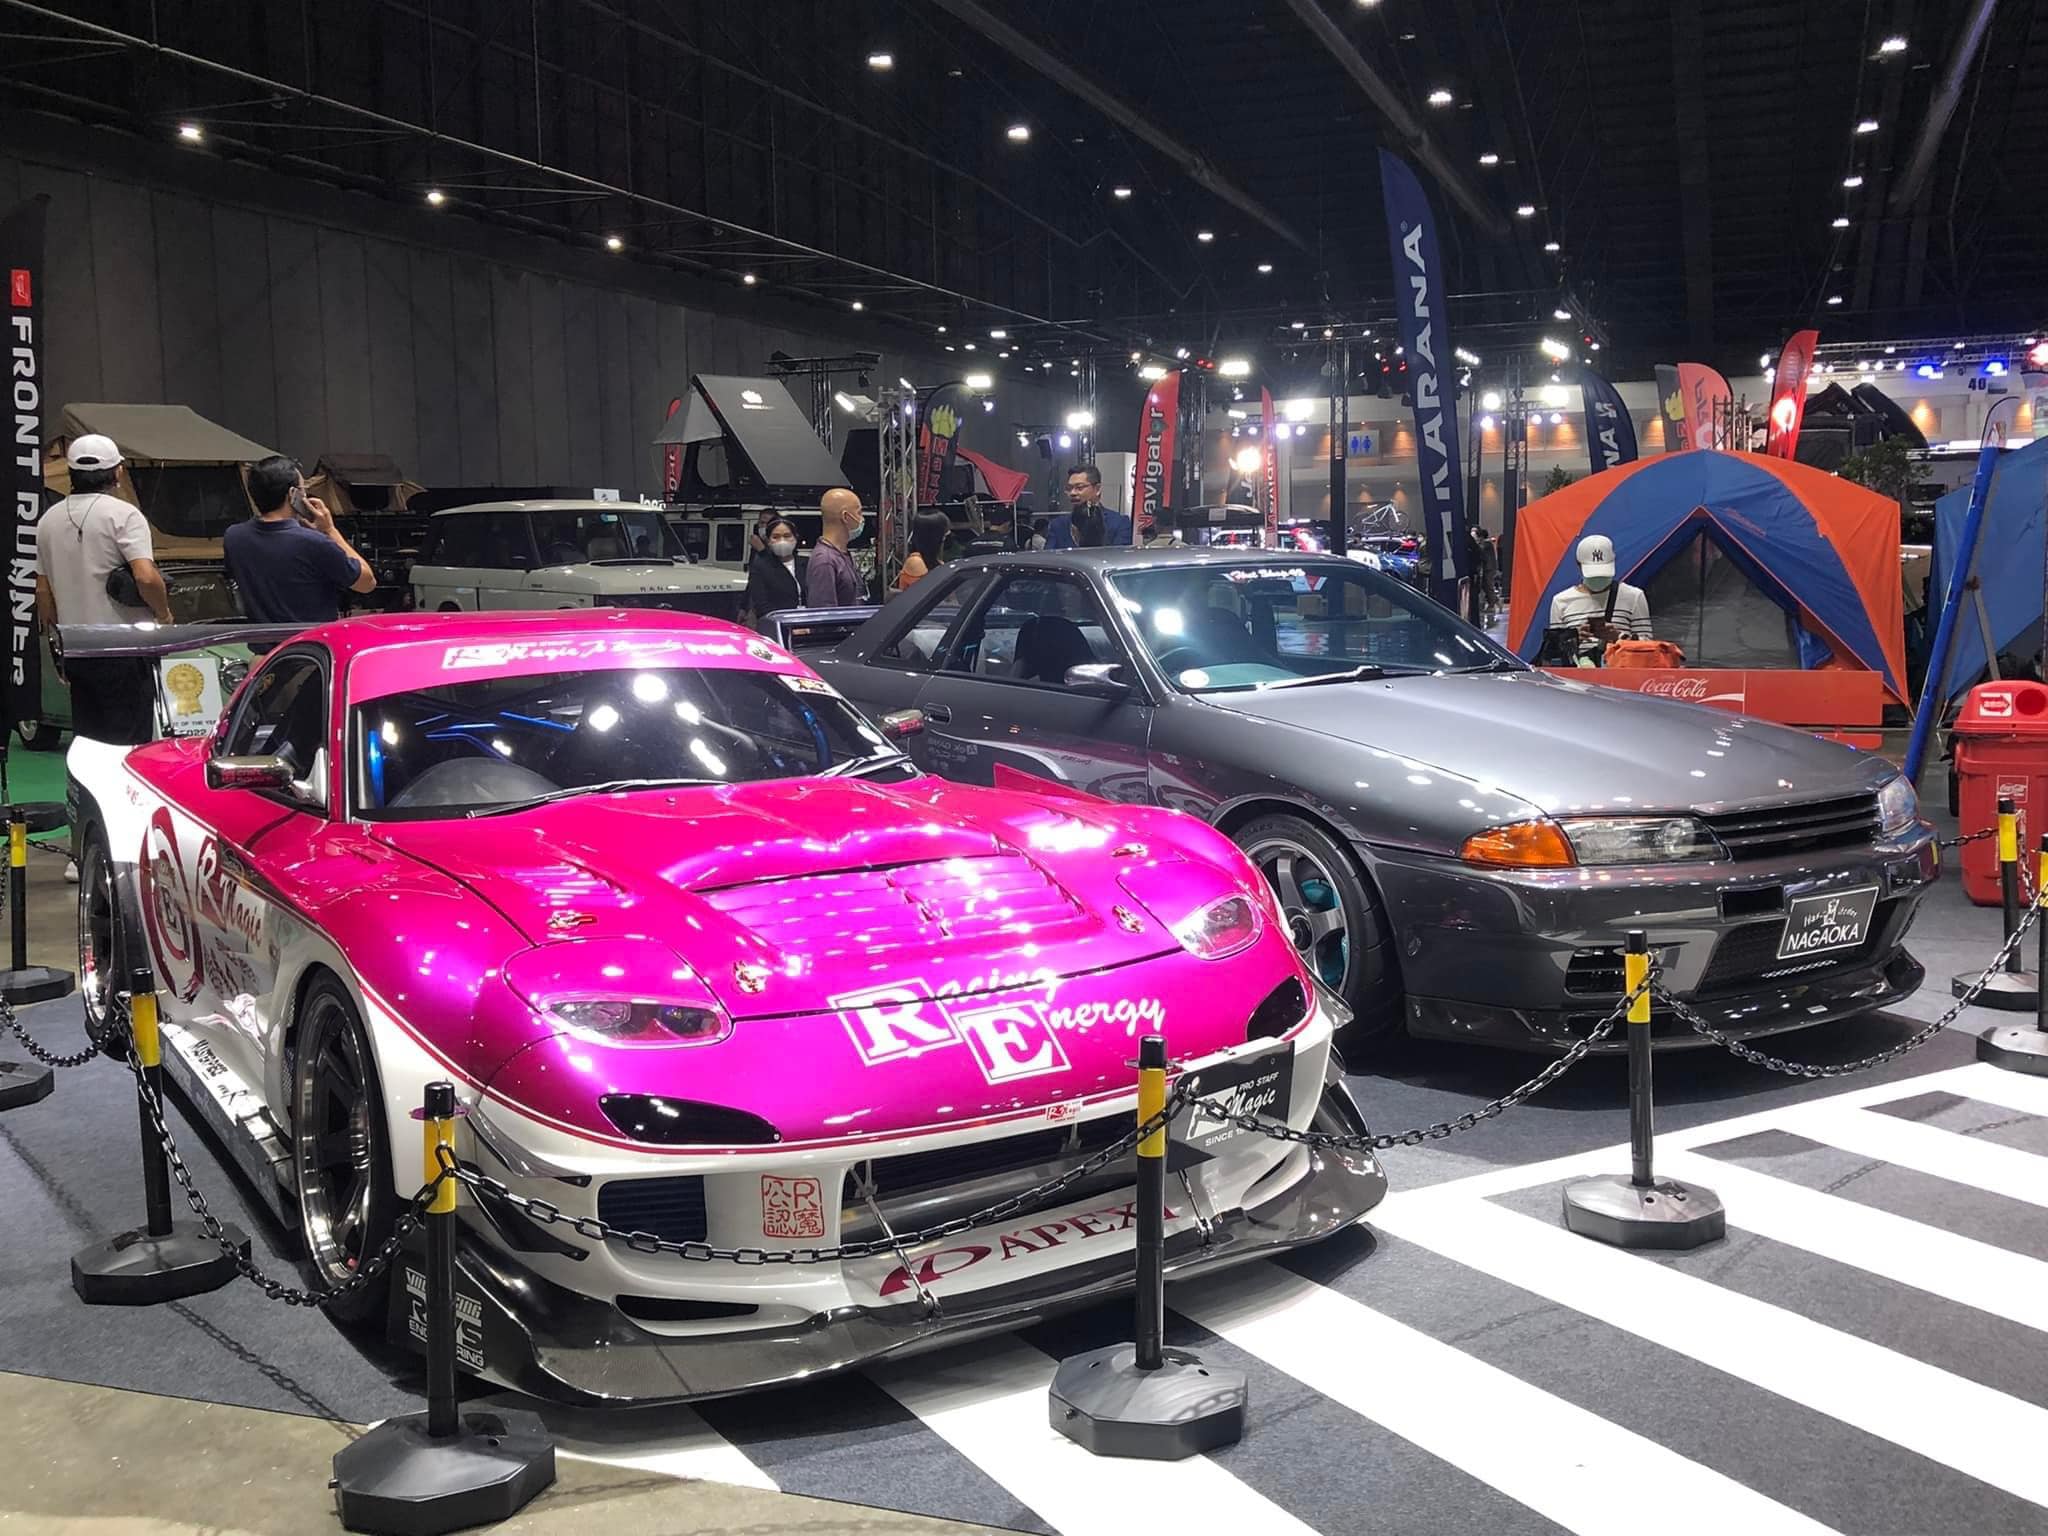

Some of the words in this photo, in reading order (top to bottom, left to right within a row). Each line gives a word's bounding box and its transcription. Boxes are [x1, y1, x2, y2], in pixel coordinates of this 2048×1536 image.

[11, 315, 40, 477] FRONT
[1967, 377, 1987, 391] 40
[8, 491, 40, 687] RUNNER
[1639, 678, 1709, 698] Coca-Cola
[1786, 922, 1859, 952] NAGAOKA
[1256, 1071, 1280, 1087] STAFF
[1225, 1088, 1276, 1117] Magic
[1205, 1128, 1234, 1147] SINCE
